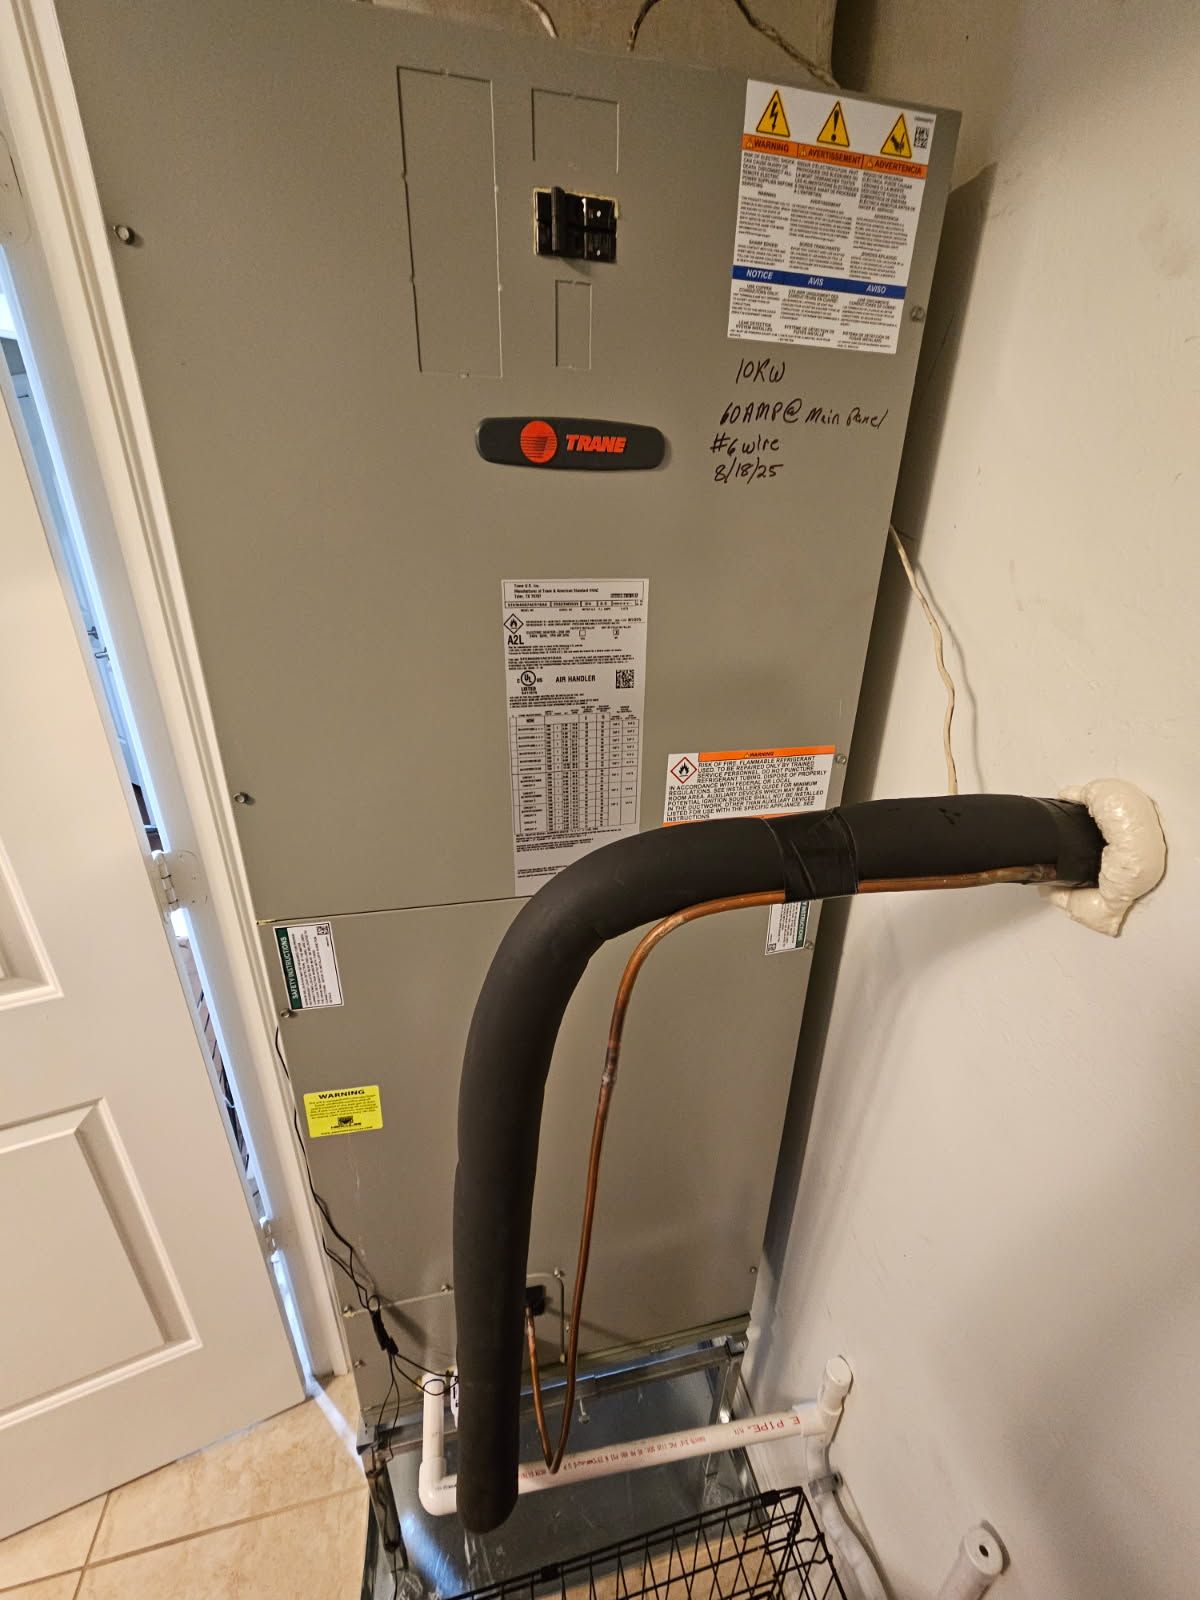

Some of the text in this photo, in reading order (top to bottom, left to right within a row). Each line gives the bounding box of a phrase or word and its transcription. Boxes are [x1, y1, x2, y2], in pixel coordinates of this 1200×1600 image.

[754, 139, 788, 153] WARNING
[807, 148, 860, 164] AVERTISSEMENT
[873, 159, 922, 175] ADVERTENCIA
[746, 268, 773, 279] NOTICE
[807, 276, 824, 286] AVIS
[866, 284, 886, 293] AVISO
[566, 434, 628, 453] TRANE
[714, 456, 784, 485] 8/18/25
[507, 634, 524, 645] A2L
[568, 674, 596, 683] HANDLER
[676, 782, 718, 790] ACCORDANCE
[280, 936, 299, 999] SAFETY INSTRUCTIONS
[319, 1089, 365, 1099] WARNING
